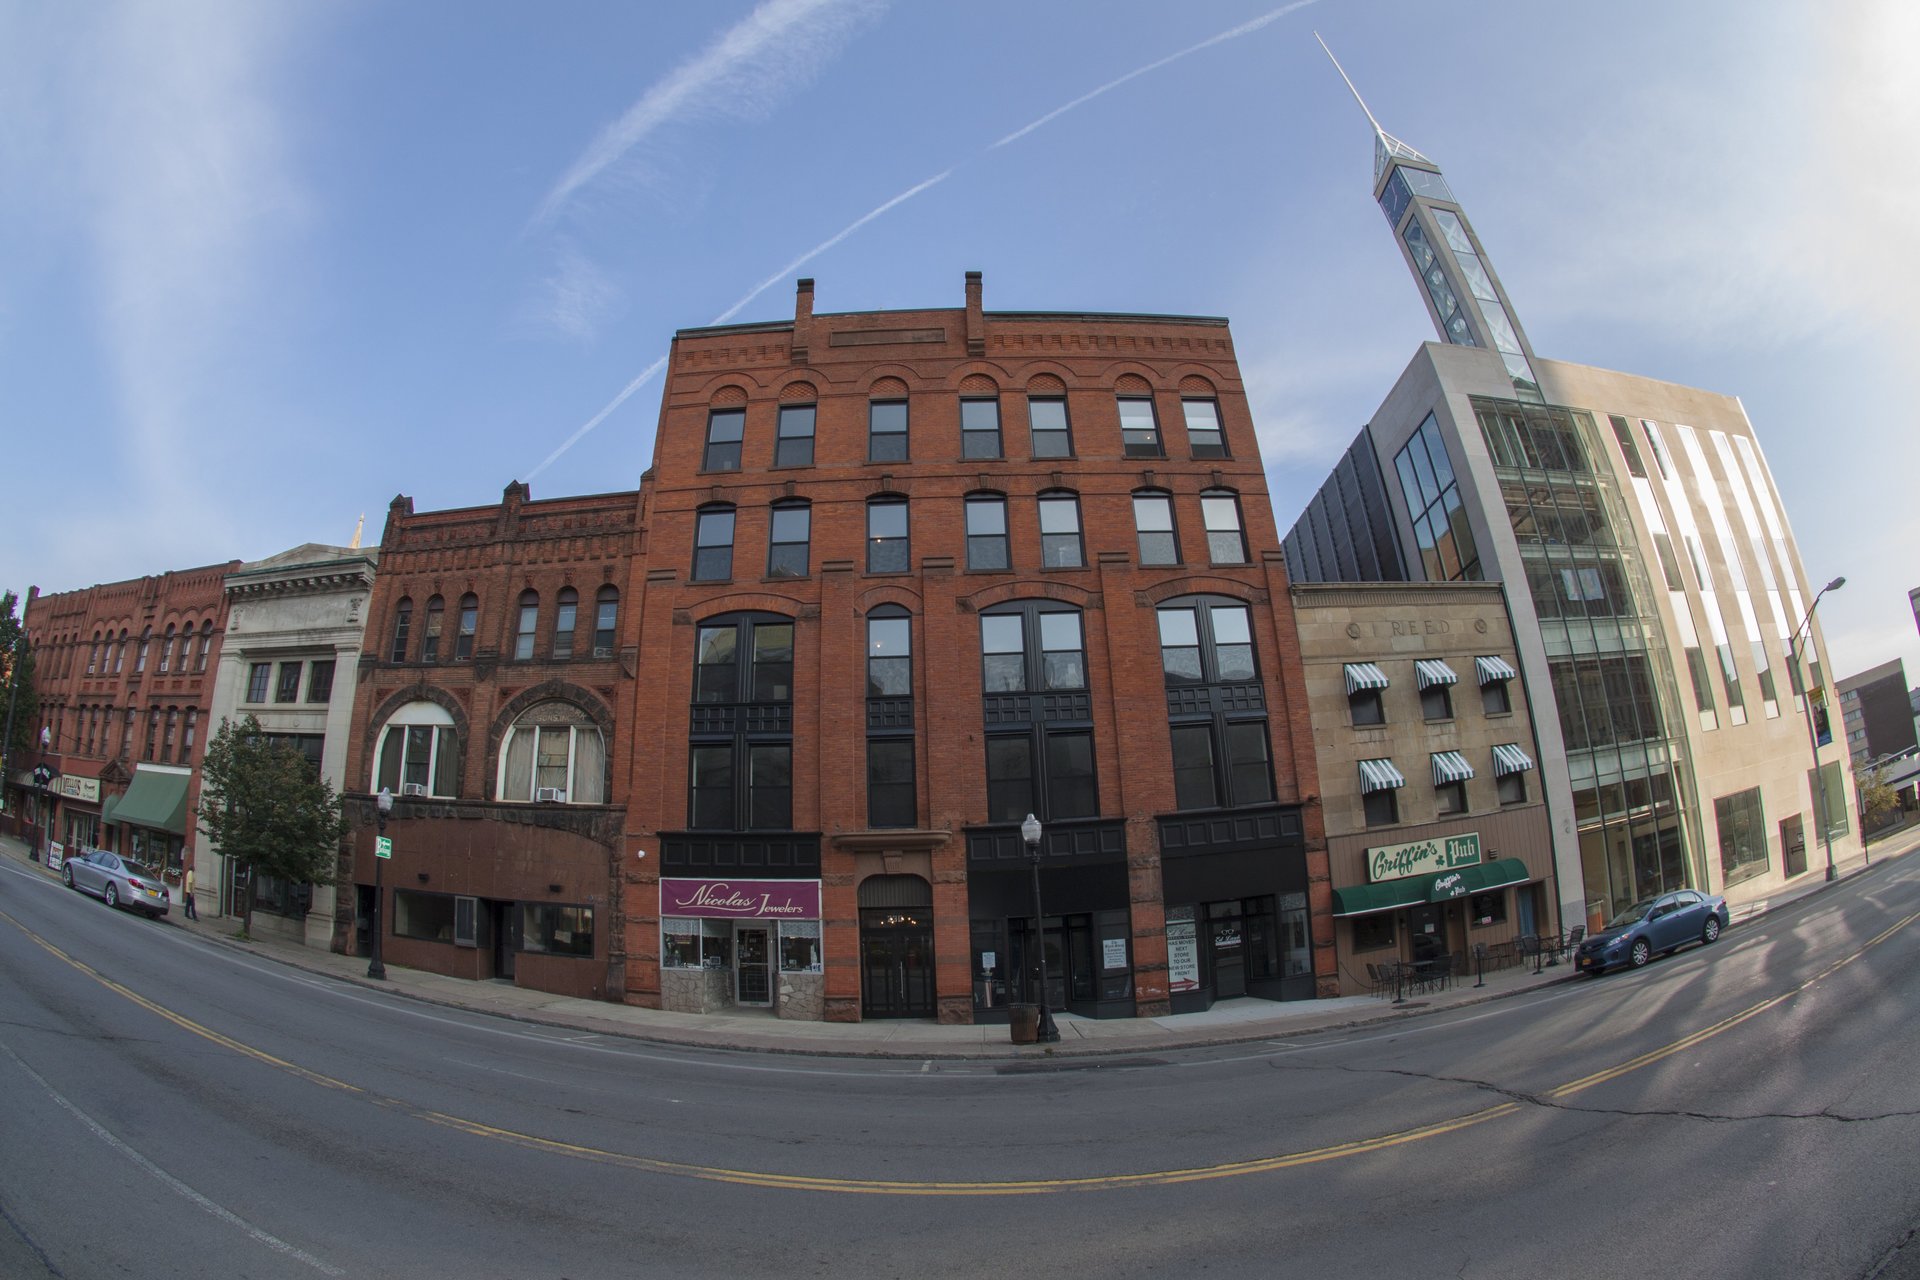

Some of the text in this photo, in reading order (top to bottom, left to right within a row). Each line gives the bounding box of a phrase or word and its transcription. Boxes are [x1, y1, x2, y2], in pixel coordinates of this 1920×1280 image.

[1391, 620, 1450, 636] REED
[1373, 839, 1476, 880] Griffin's Pub
[676, 883, 804, 917] Nicolas Jewelers
